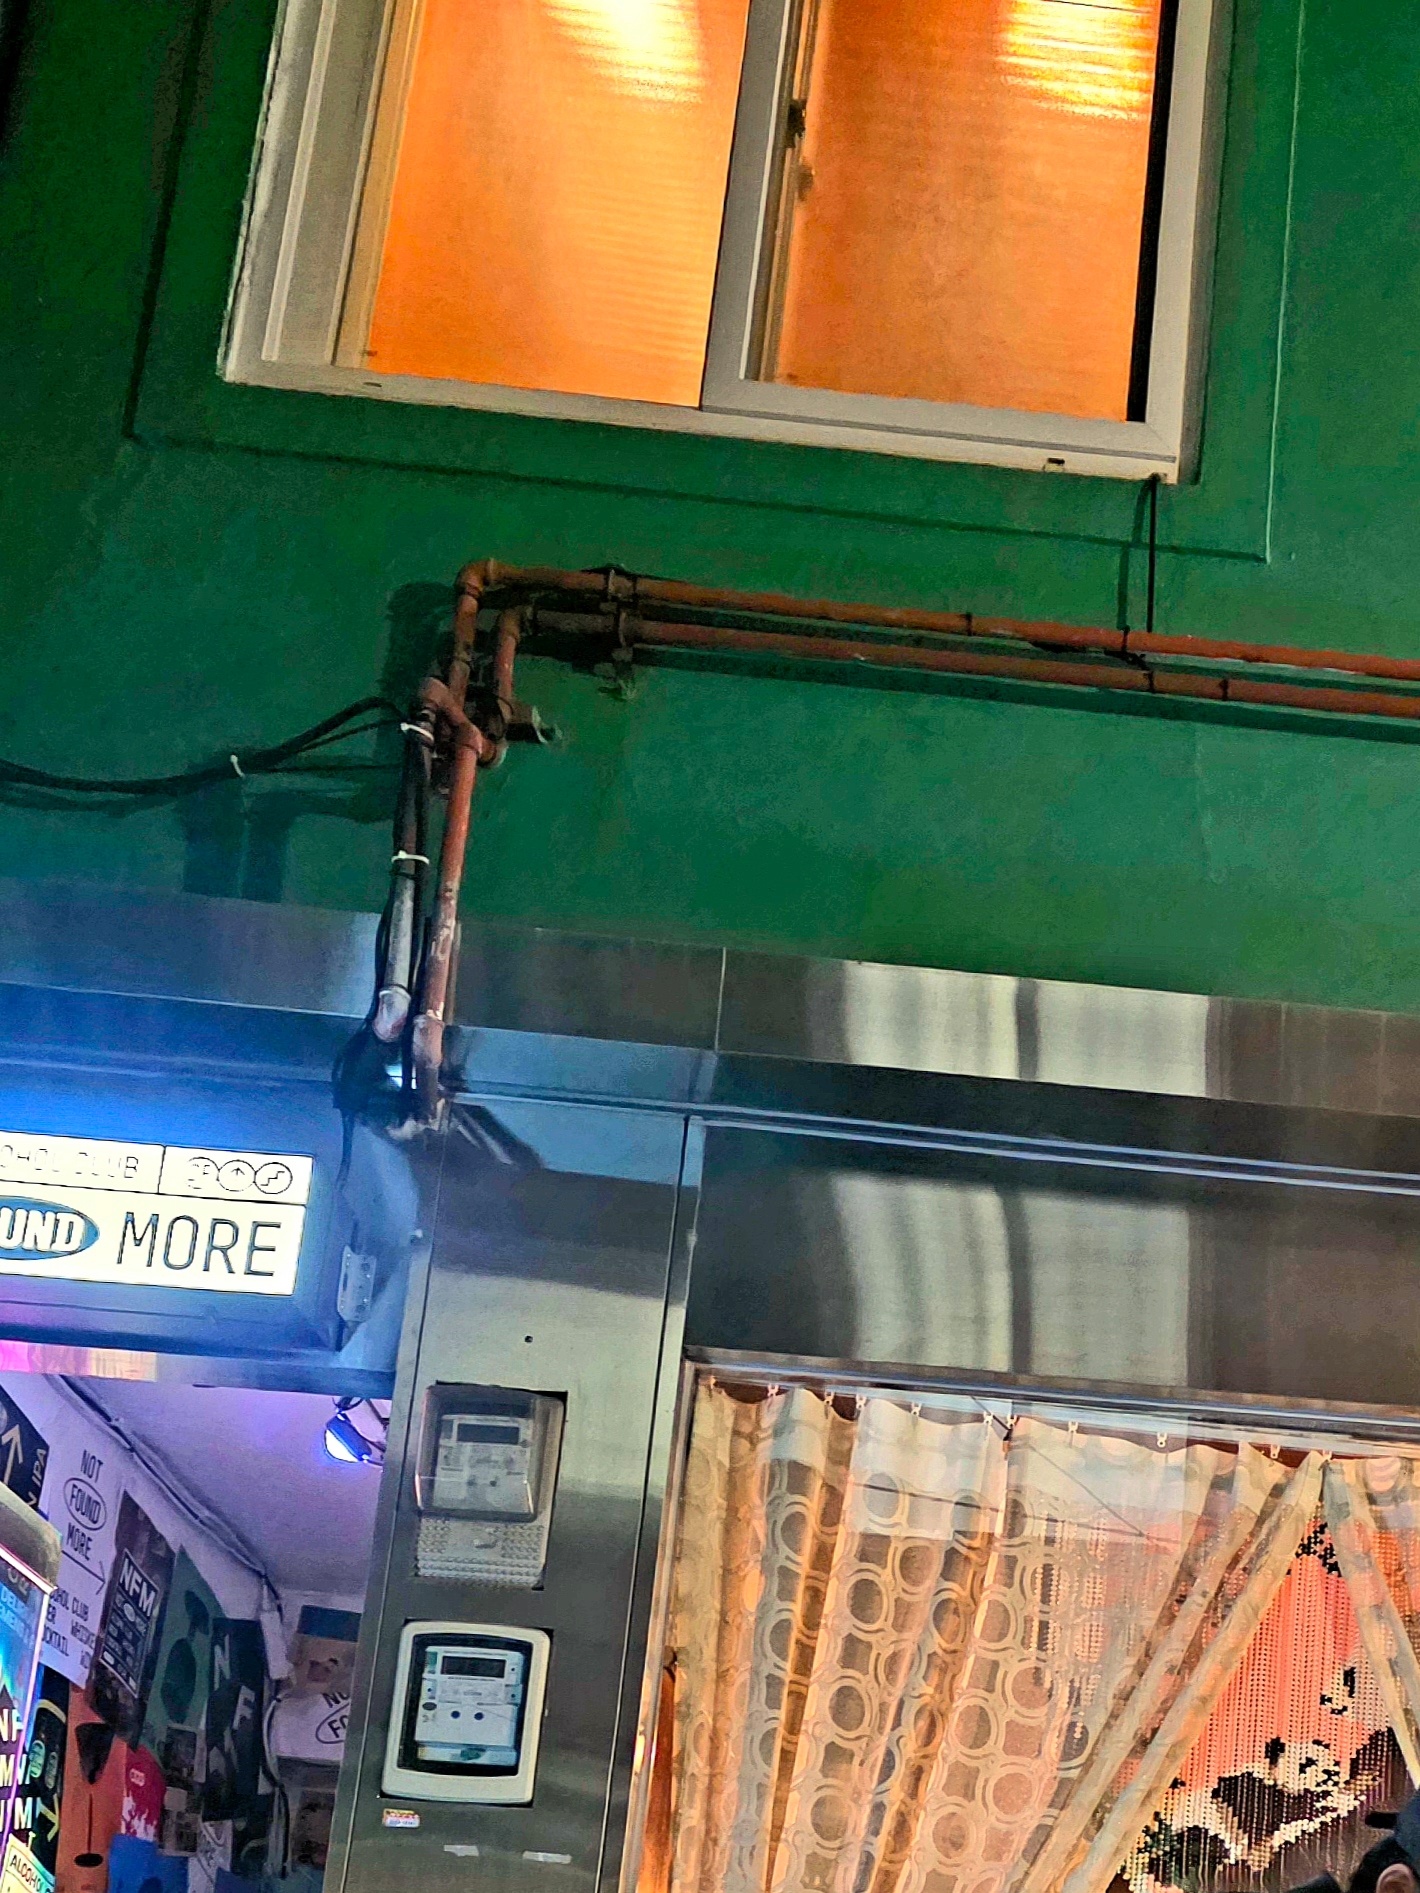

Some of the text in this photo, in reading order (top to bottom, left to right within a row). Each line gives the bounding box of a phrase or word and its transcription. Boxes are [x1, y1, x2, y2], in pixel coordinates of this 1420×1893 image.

[117, 1212, 281, 1277] MORE
[80, 1450, 103, 1483] NOT
[69, 1484, 102, 1526] FOUND
[66, 1522, 93, 1561] MORE
[119, 1557, 156, 1618] NFM
